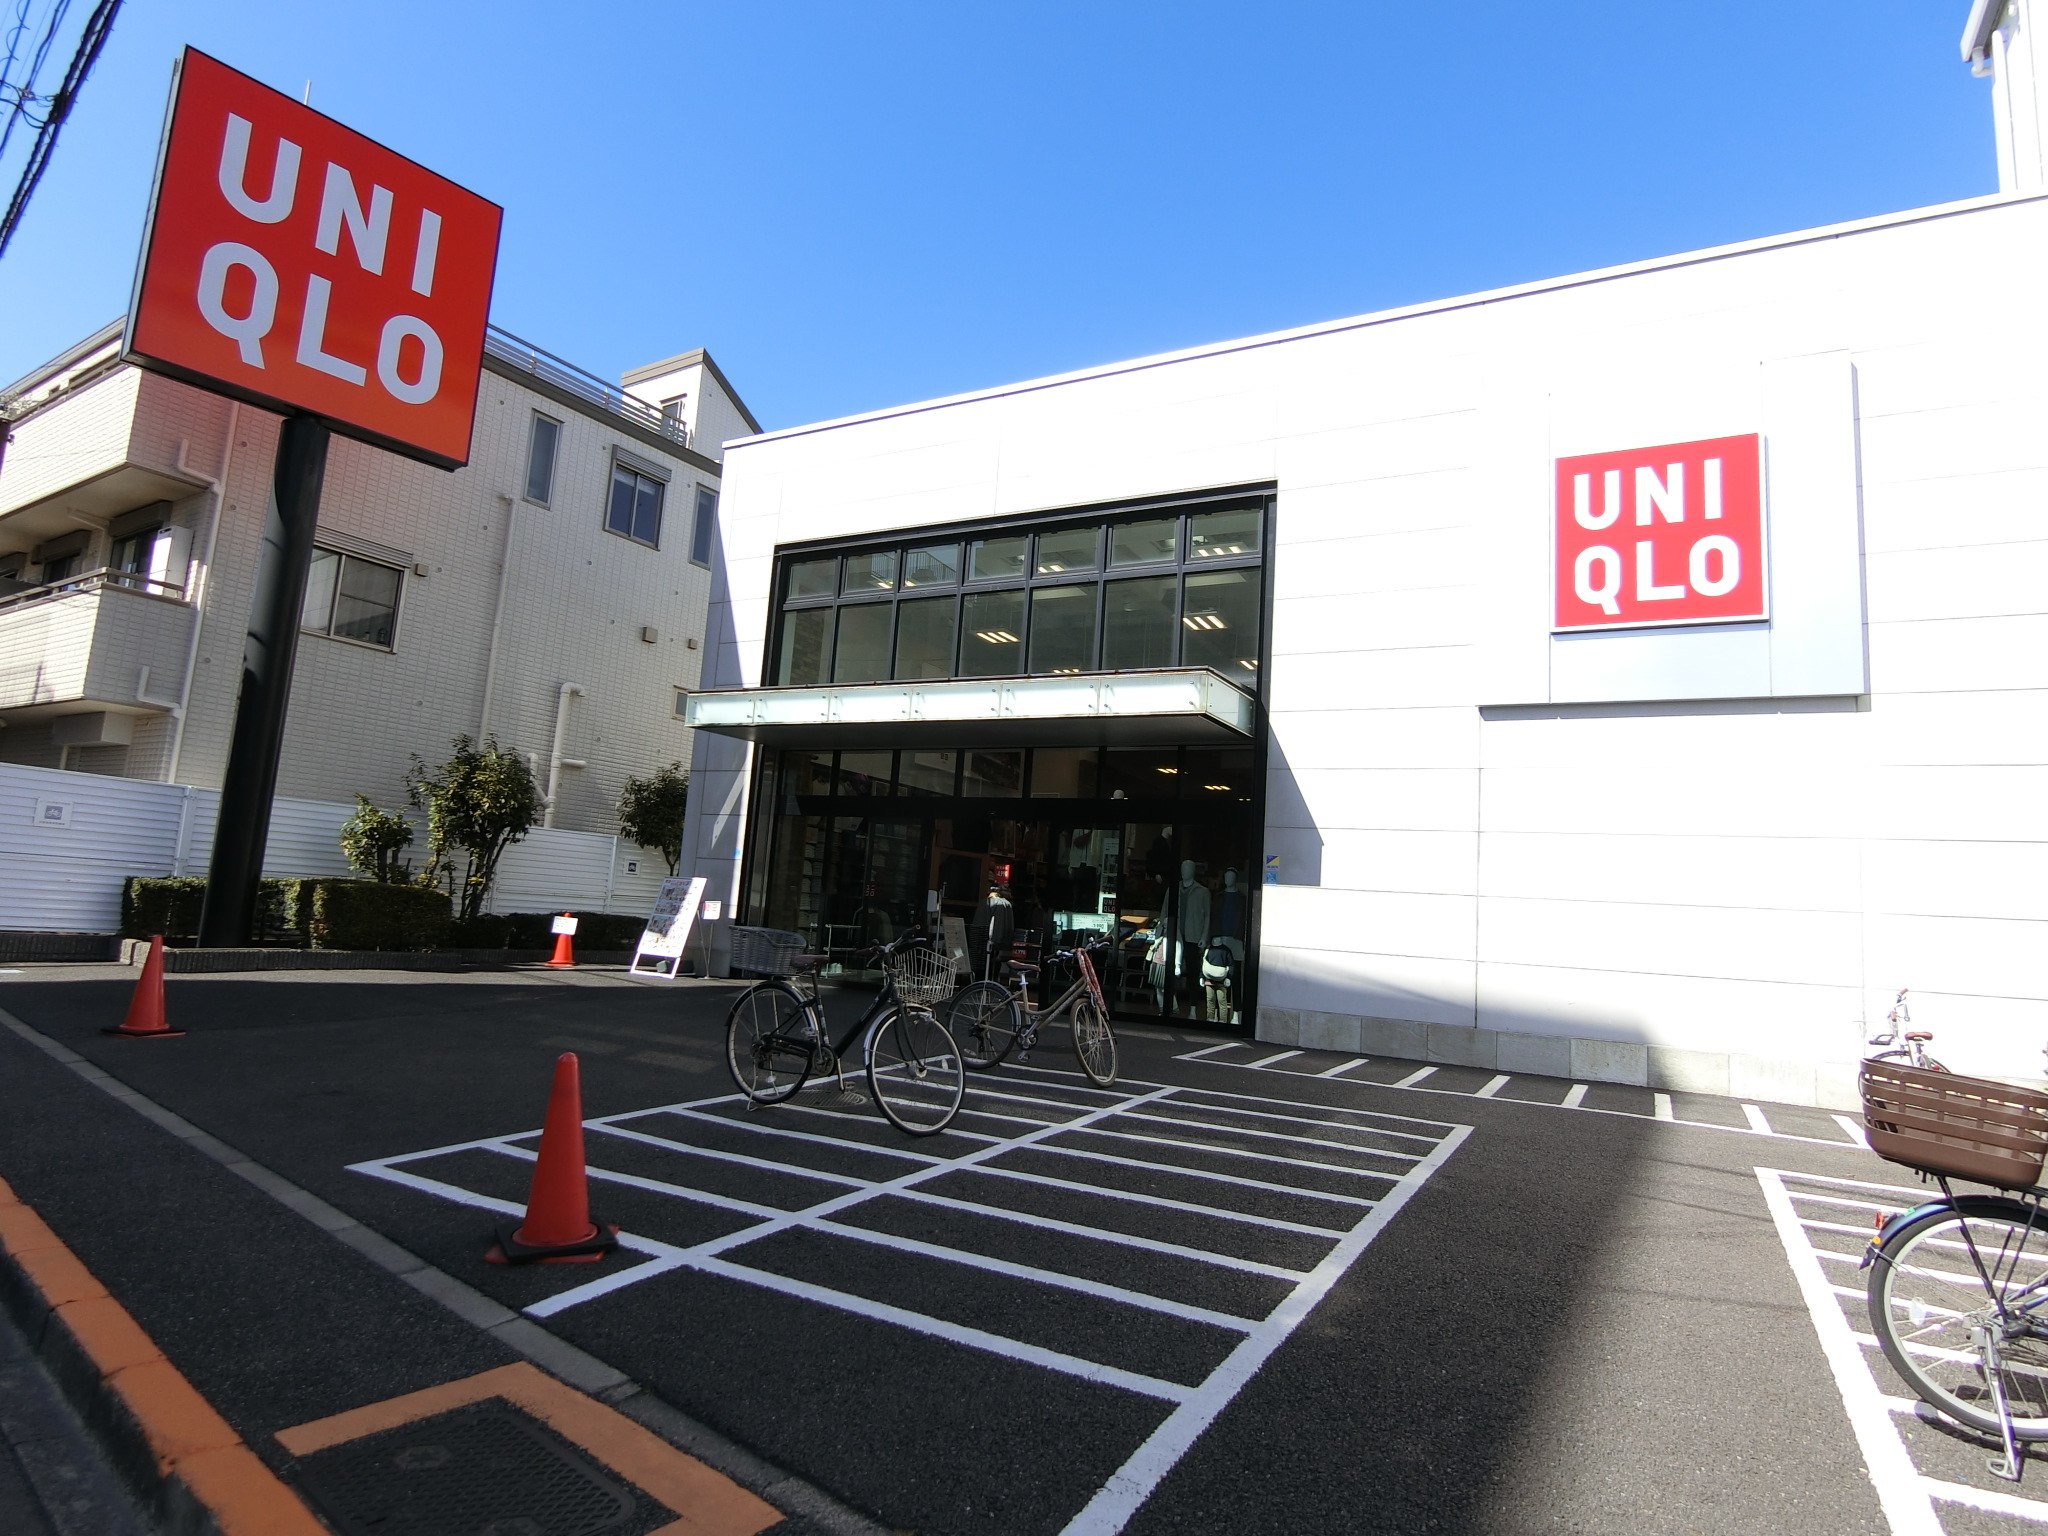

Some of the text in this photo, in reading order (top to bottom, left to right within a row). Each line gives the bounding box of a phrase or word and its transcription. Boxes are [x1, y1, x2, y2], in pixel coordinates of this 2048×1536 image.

[219, 112, 442, 298] UNI
[197, 241, 444, 405] QLO
[1573, 457, 1723, 531] UNI
[1573, 534, 1741, 616] QLO
